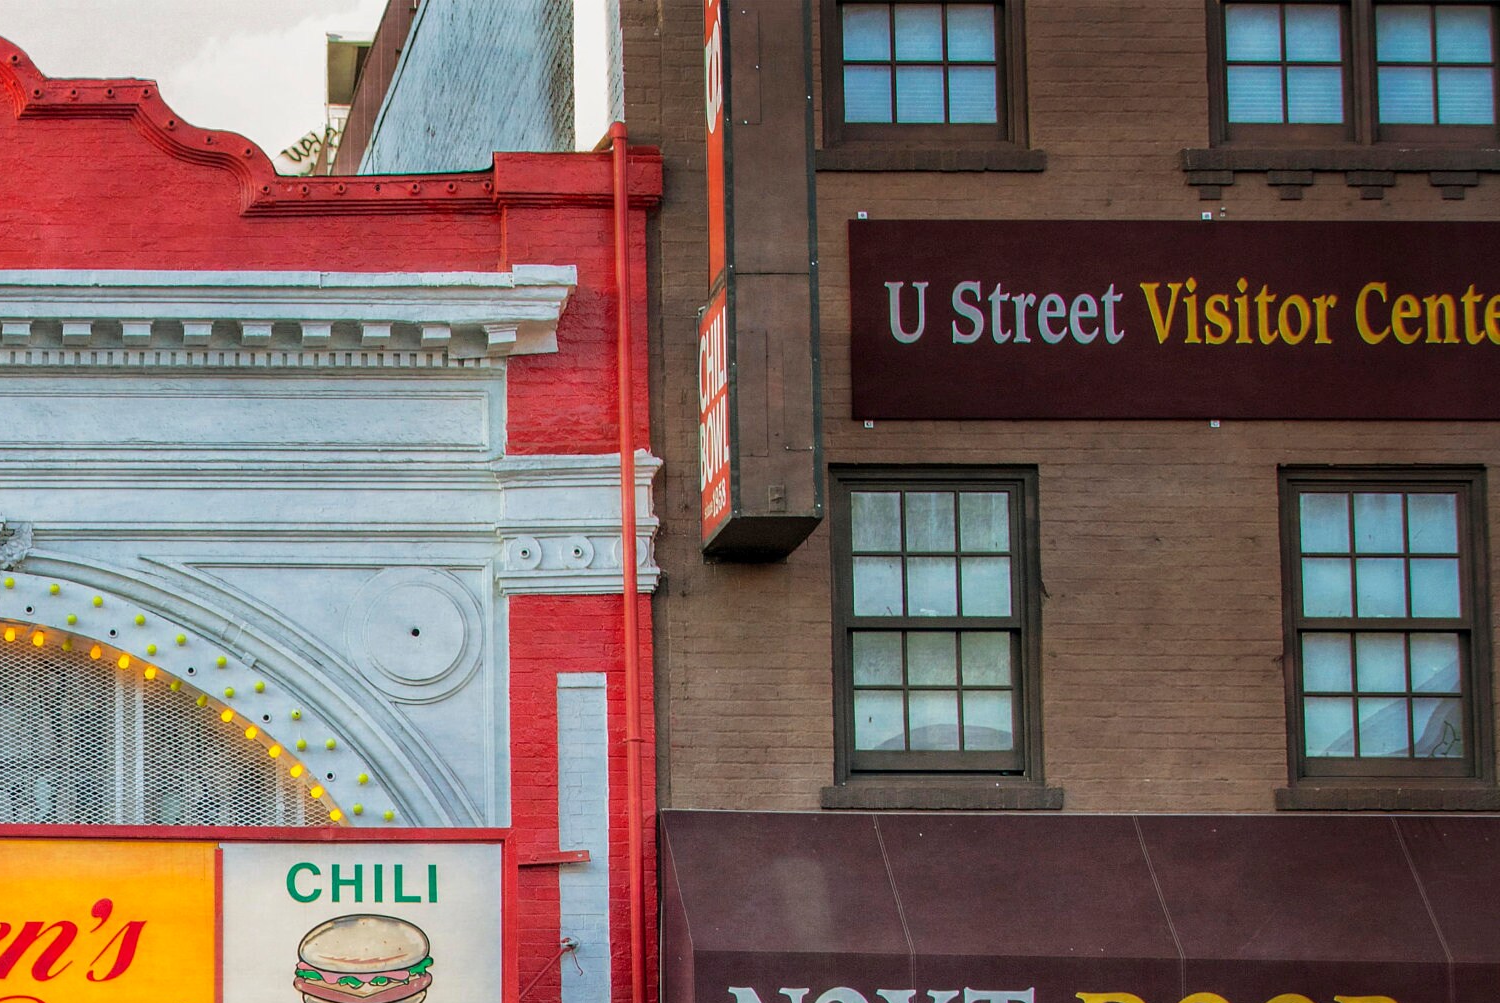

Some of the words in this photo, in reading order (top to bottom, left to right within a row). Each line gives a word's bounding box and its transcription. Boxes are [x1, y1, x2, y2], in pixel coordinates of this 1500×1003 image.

[885, 280, 929, 344] U
[951, 280, 1125, 344] Street
[1139, 276, 1338, 345] Visitor
[1355, 281, 1500, 345] Cente
[699, 306, 728, 414] CHILI
[700, 394, 729, 492] BOWL
[712, 477, 727, 518] 1958
[286, 862, 438, 903] CHILI
